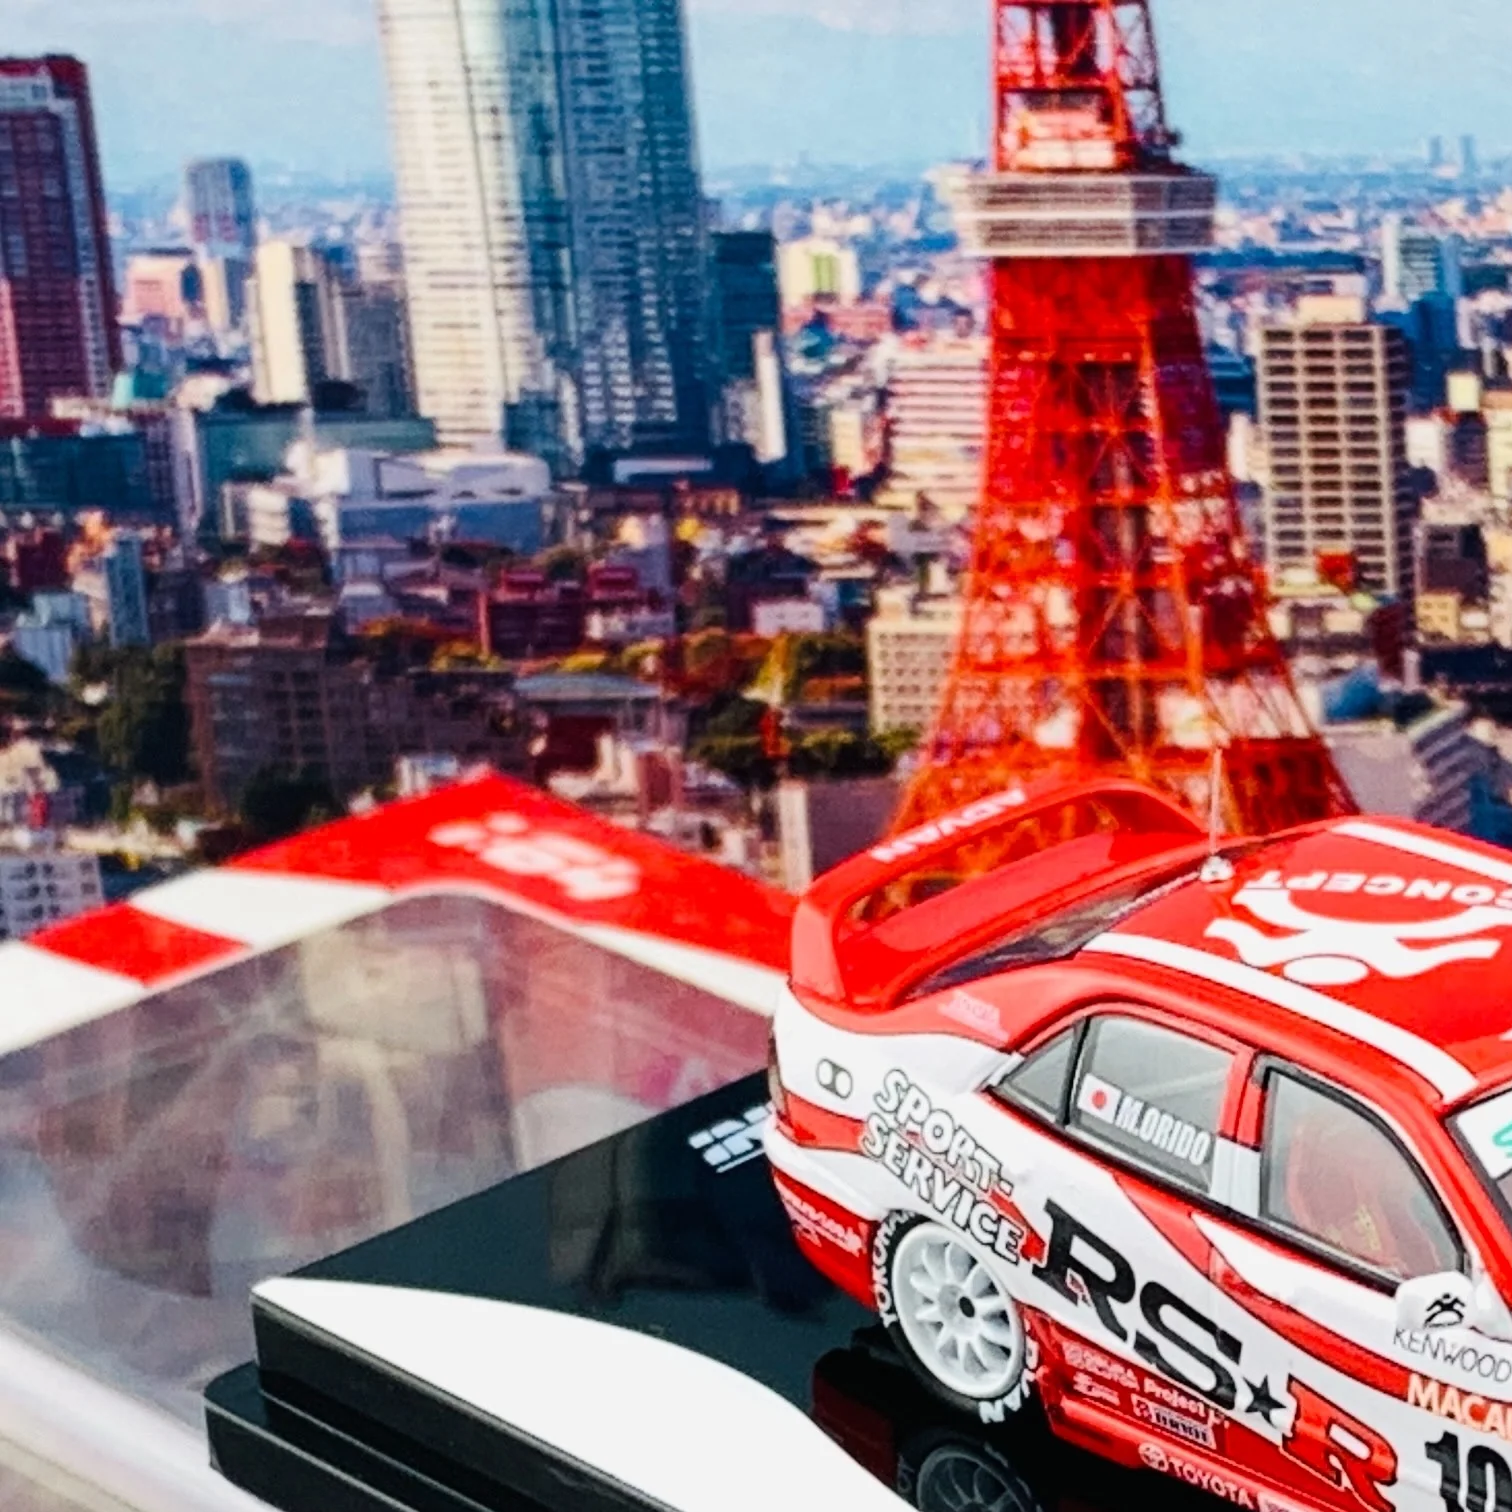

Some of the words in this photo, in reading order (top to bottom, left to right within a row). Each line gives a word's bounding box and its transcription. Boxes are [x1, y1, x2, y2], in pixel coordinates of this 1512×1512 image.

[1113, 1094, 1212, 1168] M.ORIDO
[860, 1110, 1025, 1266] SERVICE
[1393, 1326, 1512, 1384] KENWOOD
[1165, 1456, 1255, 1511] TOYOTA
